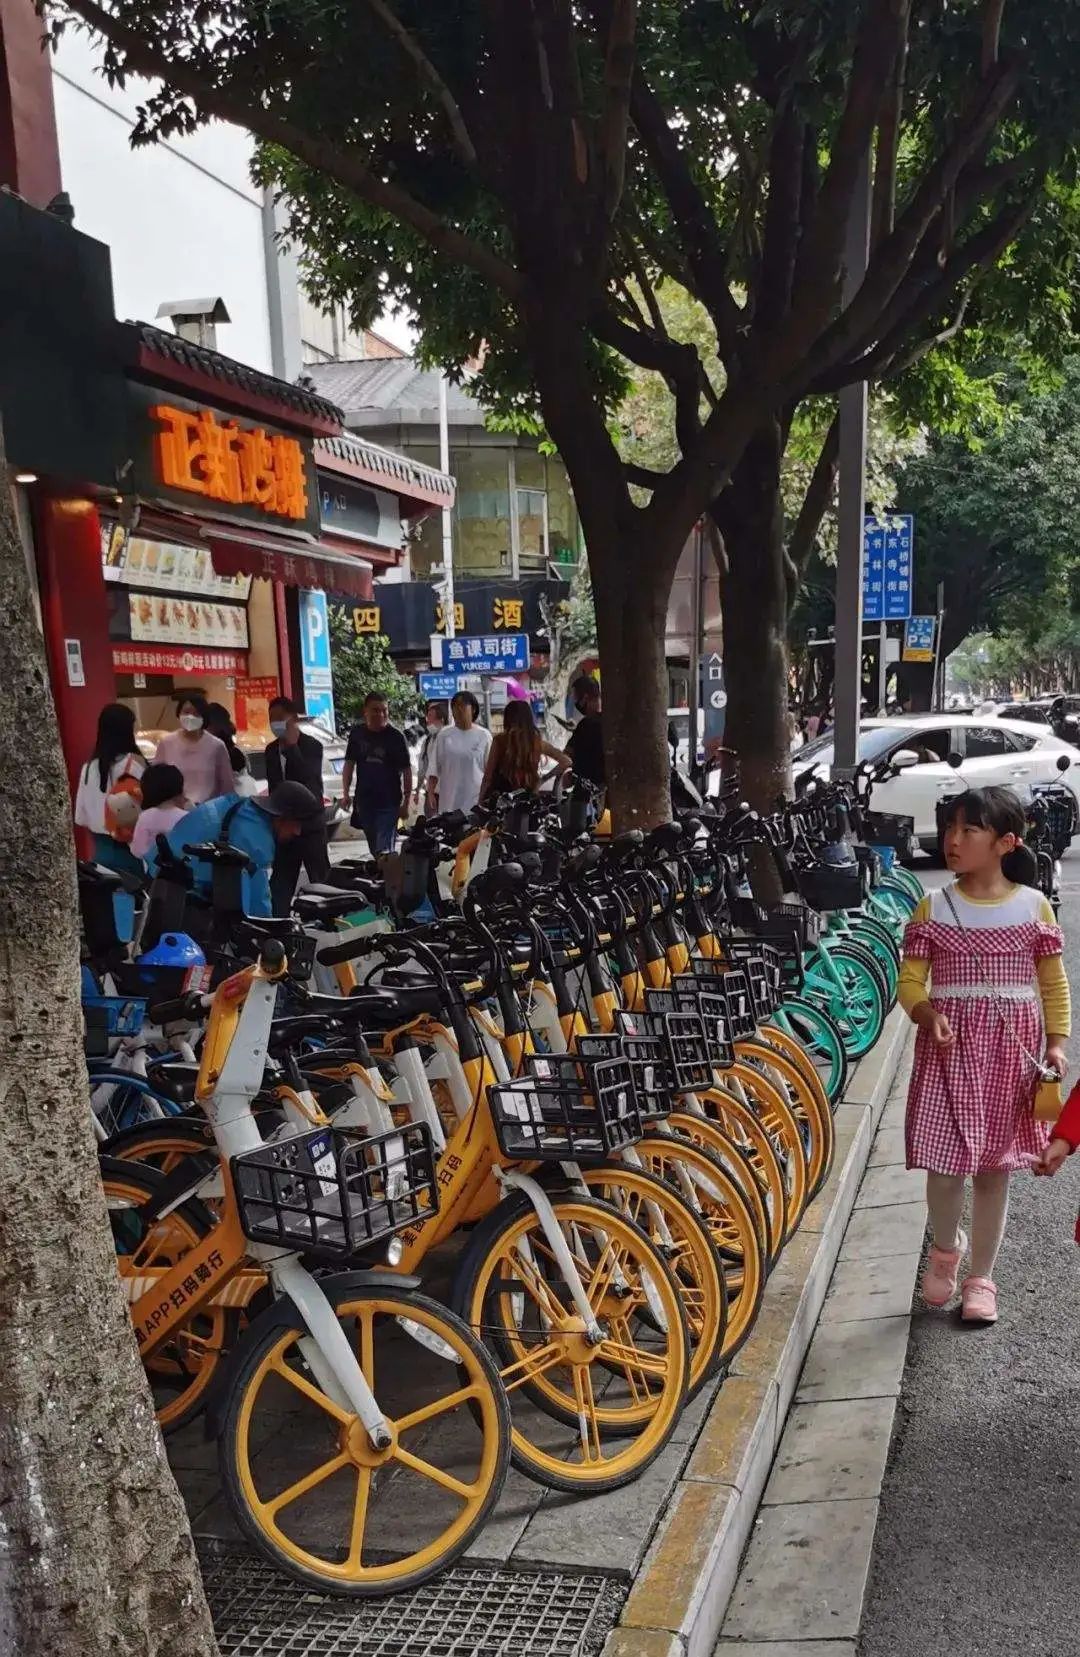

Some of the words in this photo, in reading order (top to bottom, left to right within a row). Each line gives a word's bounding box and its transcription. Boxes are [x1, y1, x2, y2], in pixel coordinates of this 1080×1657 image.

[353, 607, 380, 633] 四
[307, 606, 323, 662] P
[448, 637, 517, 659] 鱼课司街
[461, 661, 491, 671] YUKESI
